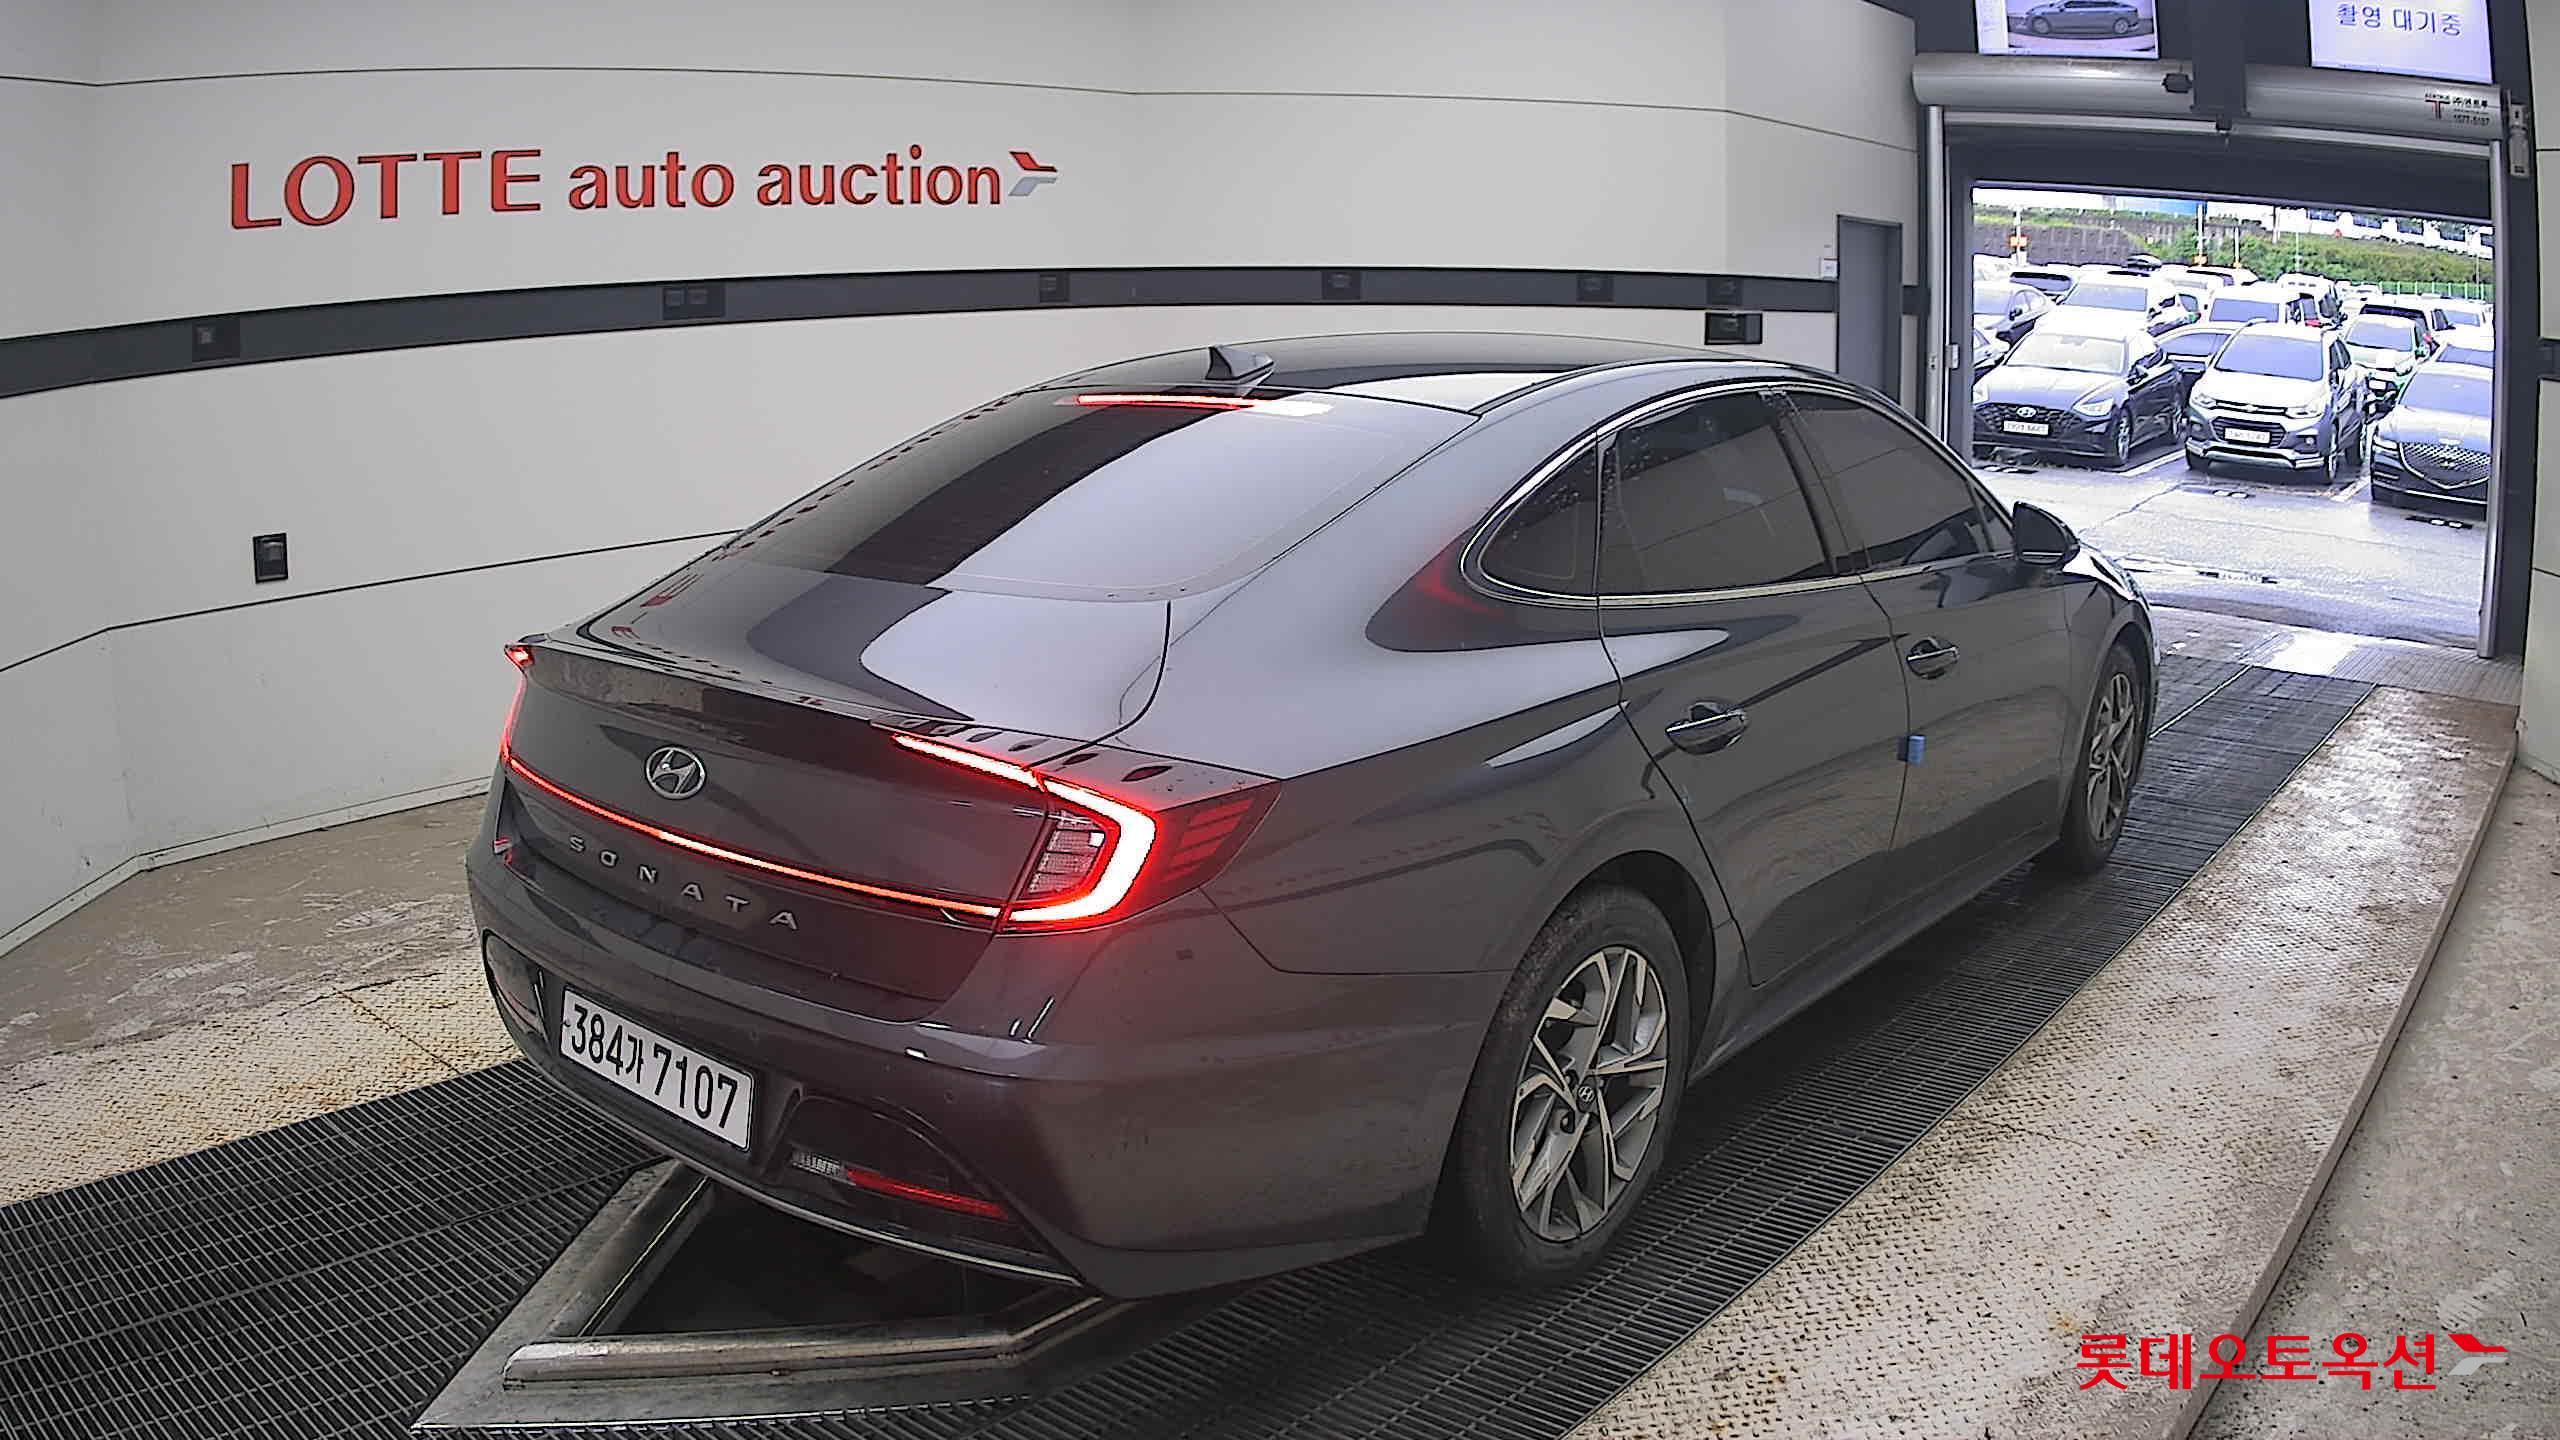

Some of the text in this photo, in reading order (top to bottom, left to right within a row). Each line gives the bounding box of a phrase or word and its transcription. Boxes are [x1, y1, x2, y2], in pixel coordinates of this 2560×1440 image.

[2337, 3, 2461, 36] 촬영 대기중
[231, 144, 1001, 230] LOTTE auto auction
[568, 835, 799, 931] SONATA
